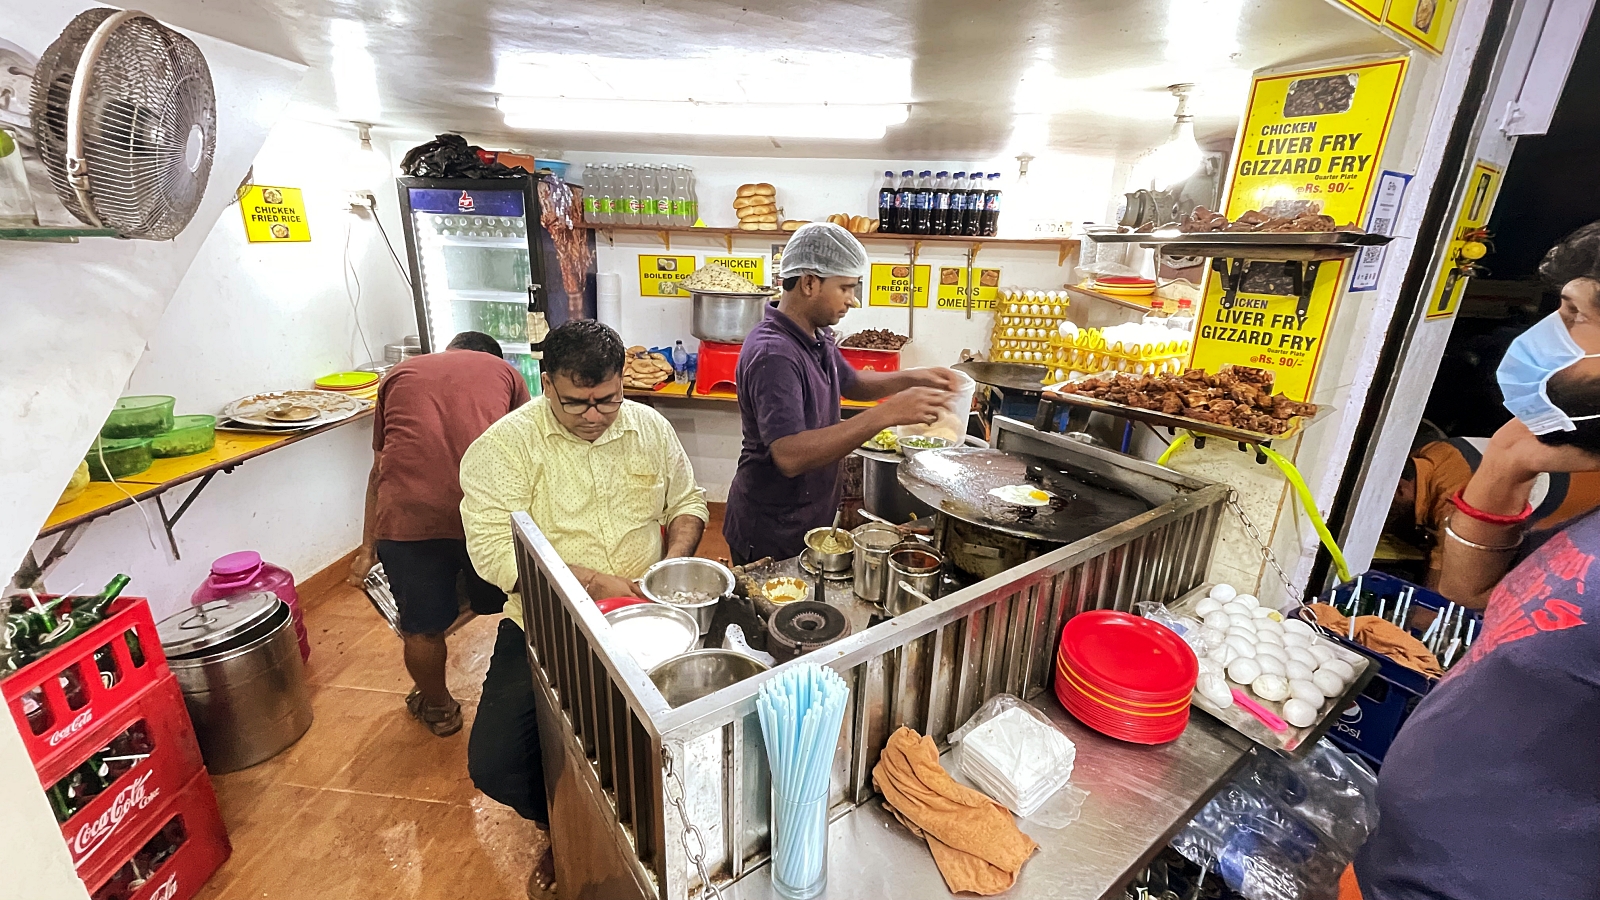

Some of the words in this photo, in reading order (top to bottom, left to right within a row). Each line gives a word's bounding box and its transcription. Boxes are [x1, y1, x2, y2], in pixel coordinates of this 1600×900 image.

[1261, 121, 1317, 136] CHICKEN
[1256, 136, 1313, 156] LIVER
[1319, 132, 1362, 152] FRY
[1240, 157, 1321, 176] GIZZARD
[1327, 154, 1371, 173] FRY
[1327, 181, 1354, 194] 90/-
[254, 206, 296, 215] CHICKEN
[251, 214, 279, 222] FRIED
[281, 215, 302, 223] RICE
[937, 297, 997, 309] OMELETTE
[1219, 296, 1269, 310] CICKEN
[1215, 308, 1266, 327] LIVER
[1270, 313, 1309, 331] FRY
[1201, 325, 1273, 346] GIZZARD
[1278, 334, 1318, 352] FRY
[1267, 347, 1289, 355] Quarter
[1278, 356, 1303, 369] 90/-
[1332, 721, 1362, 740] psi
